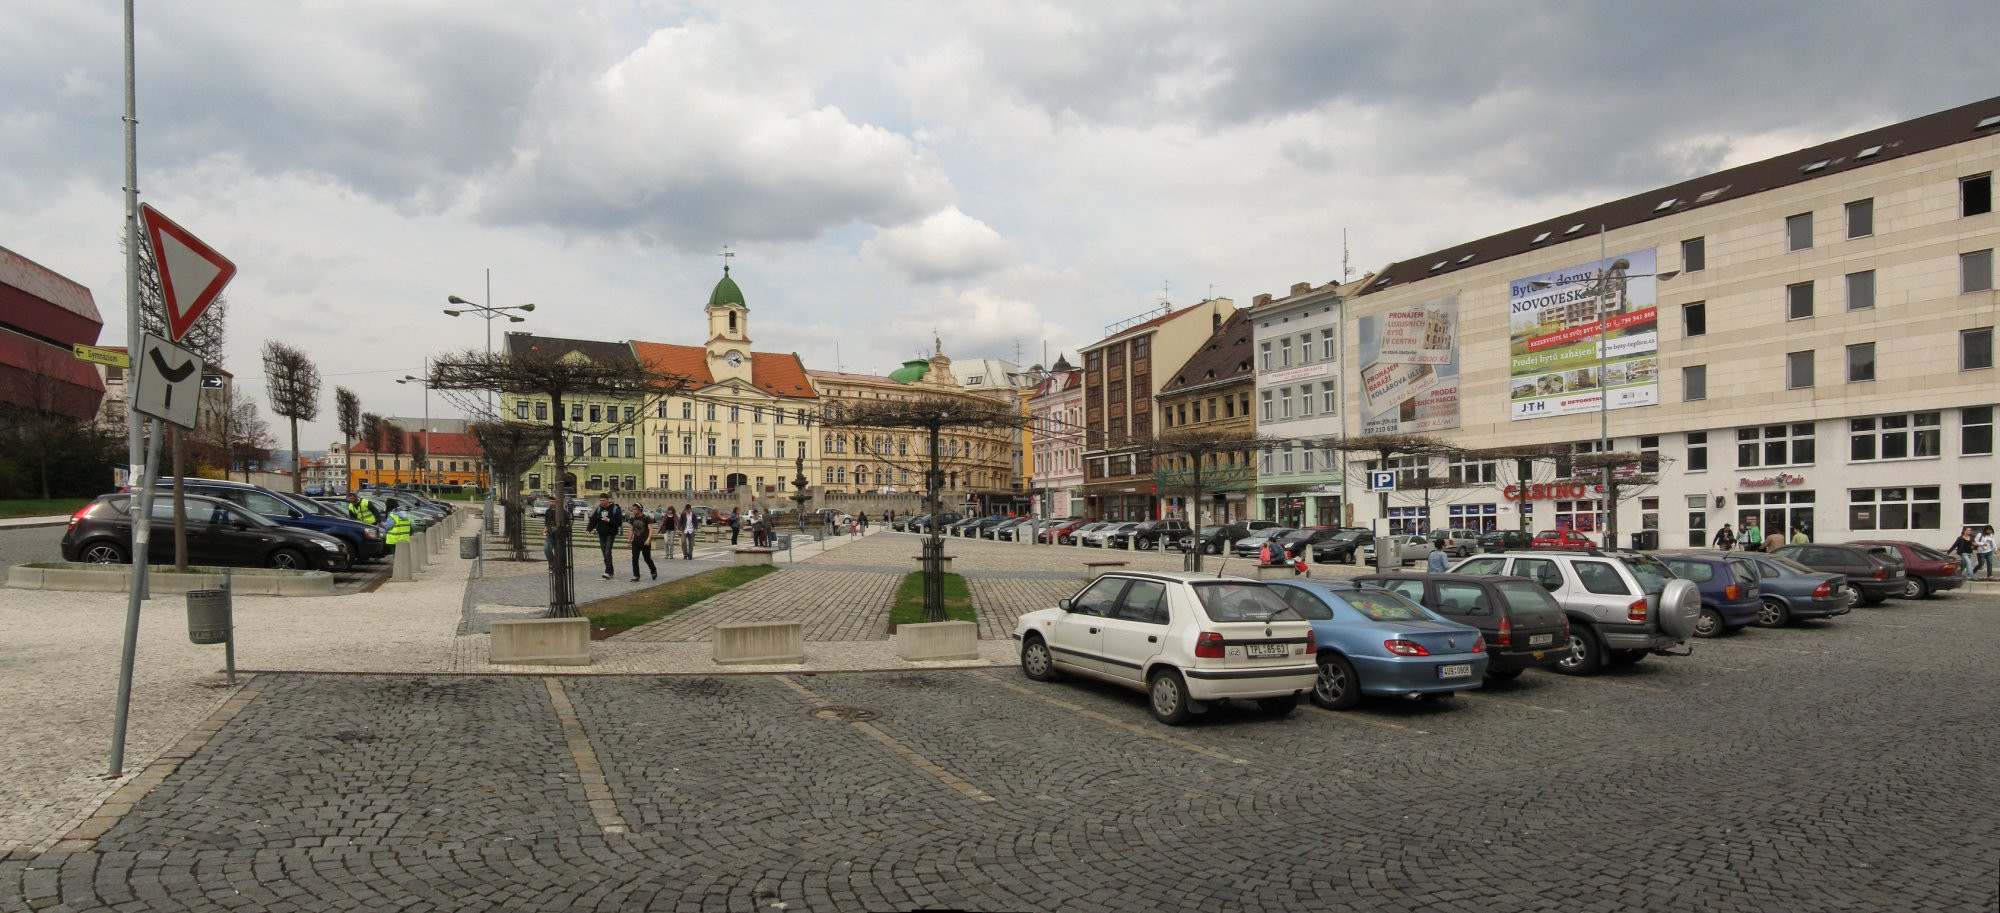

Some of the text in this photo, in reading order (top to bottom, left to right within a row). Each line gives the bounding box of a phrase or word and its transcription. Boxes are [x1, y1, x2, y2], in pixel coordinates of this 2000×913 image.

[1512, 272, 1592, 298] Byt domy
[1512, 289, 1587, 313] NOVOVESK
[1594, 322, 1612, 331] VČS!
[1598, 339, 1655, 352] ww.byty-teplice.cz
[88, 349, 118, 363] Gymnázium
[1513, 348, 1595, 367] Prodej bytů zahájen!
[1431, 387, 1457, 397] PRODEJ
[1378, 474, 1391, 486] P
[1503, 482, 1585, 501] CASINO
